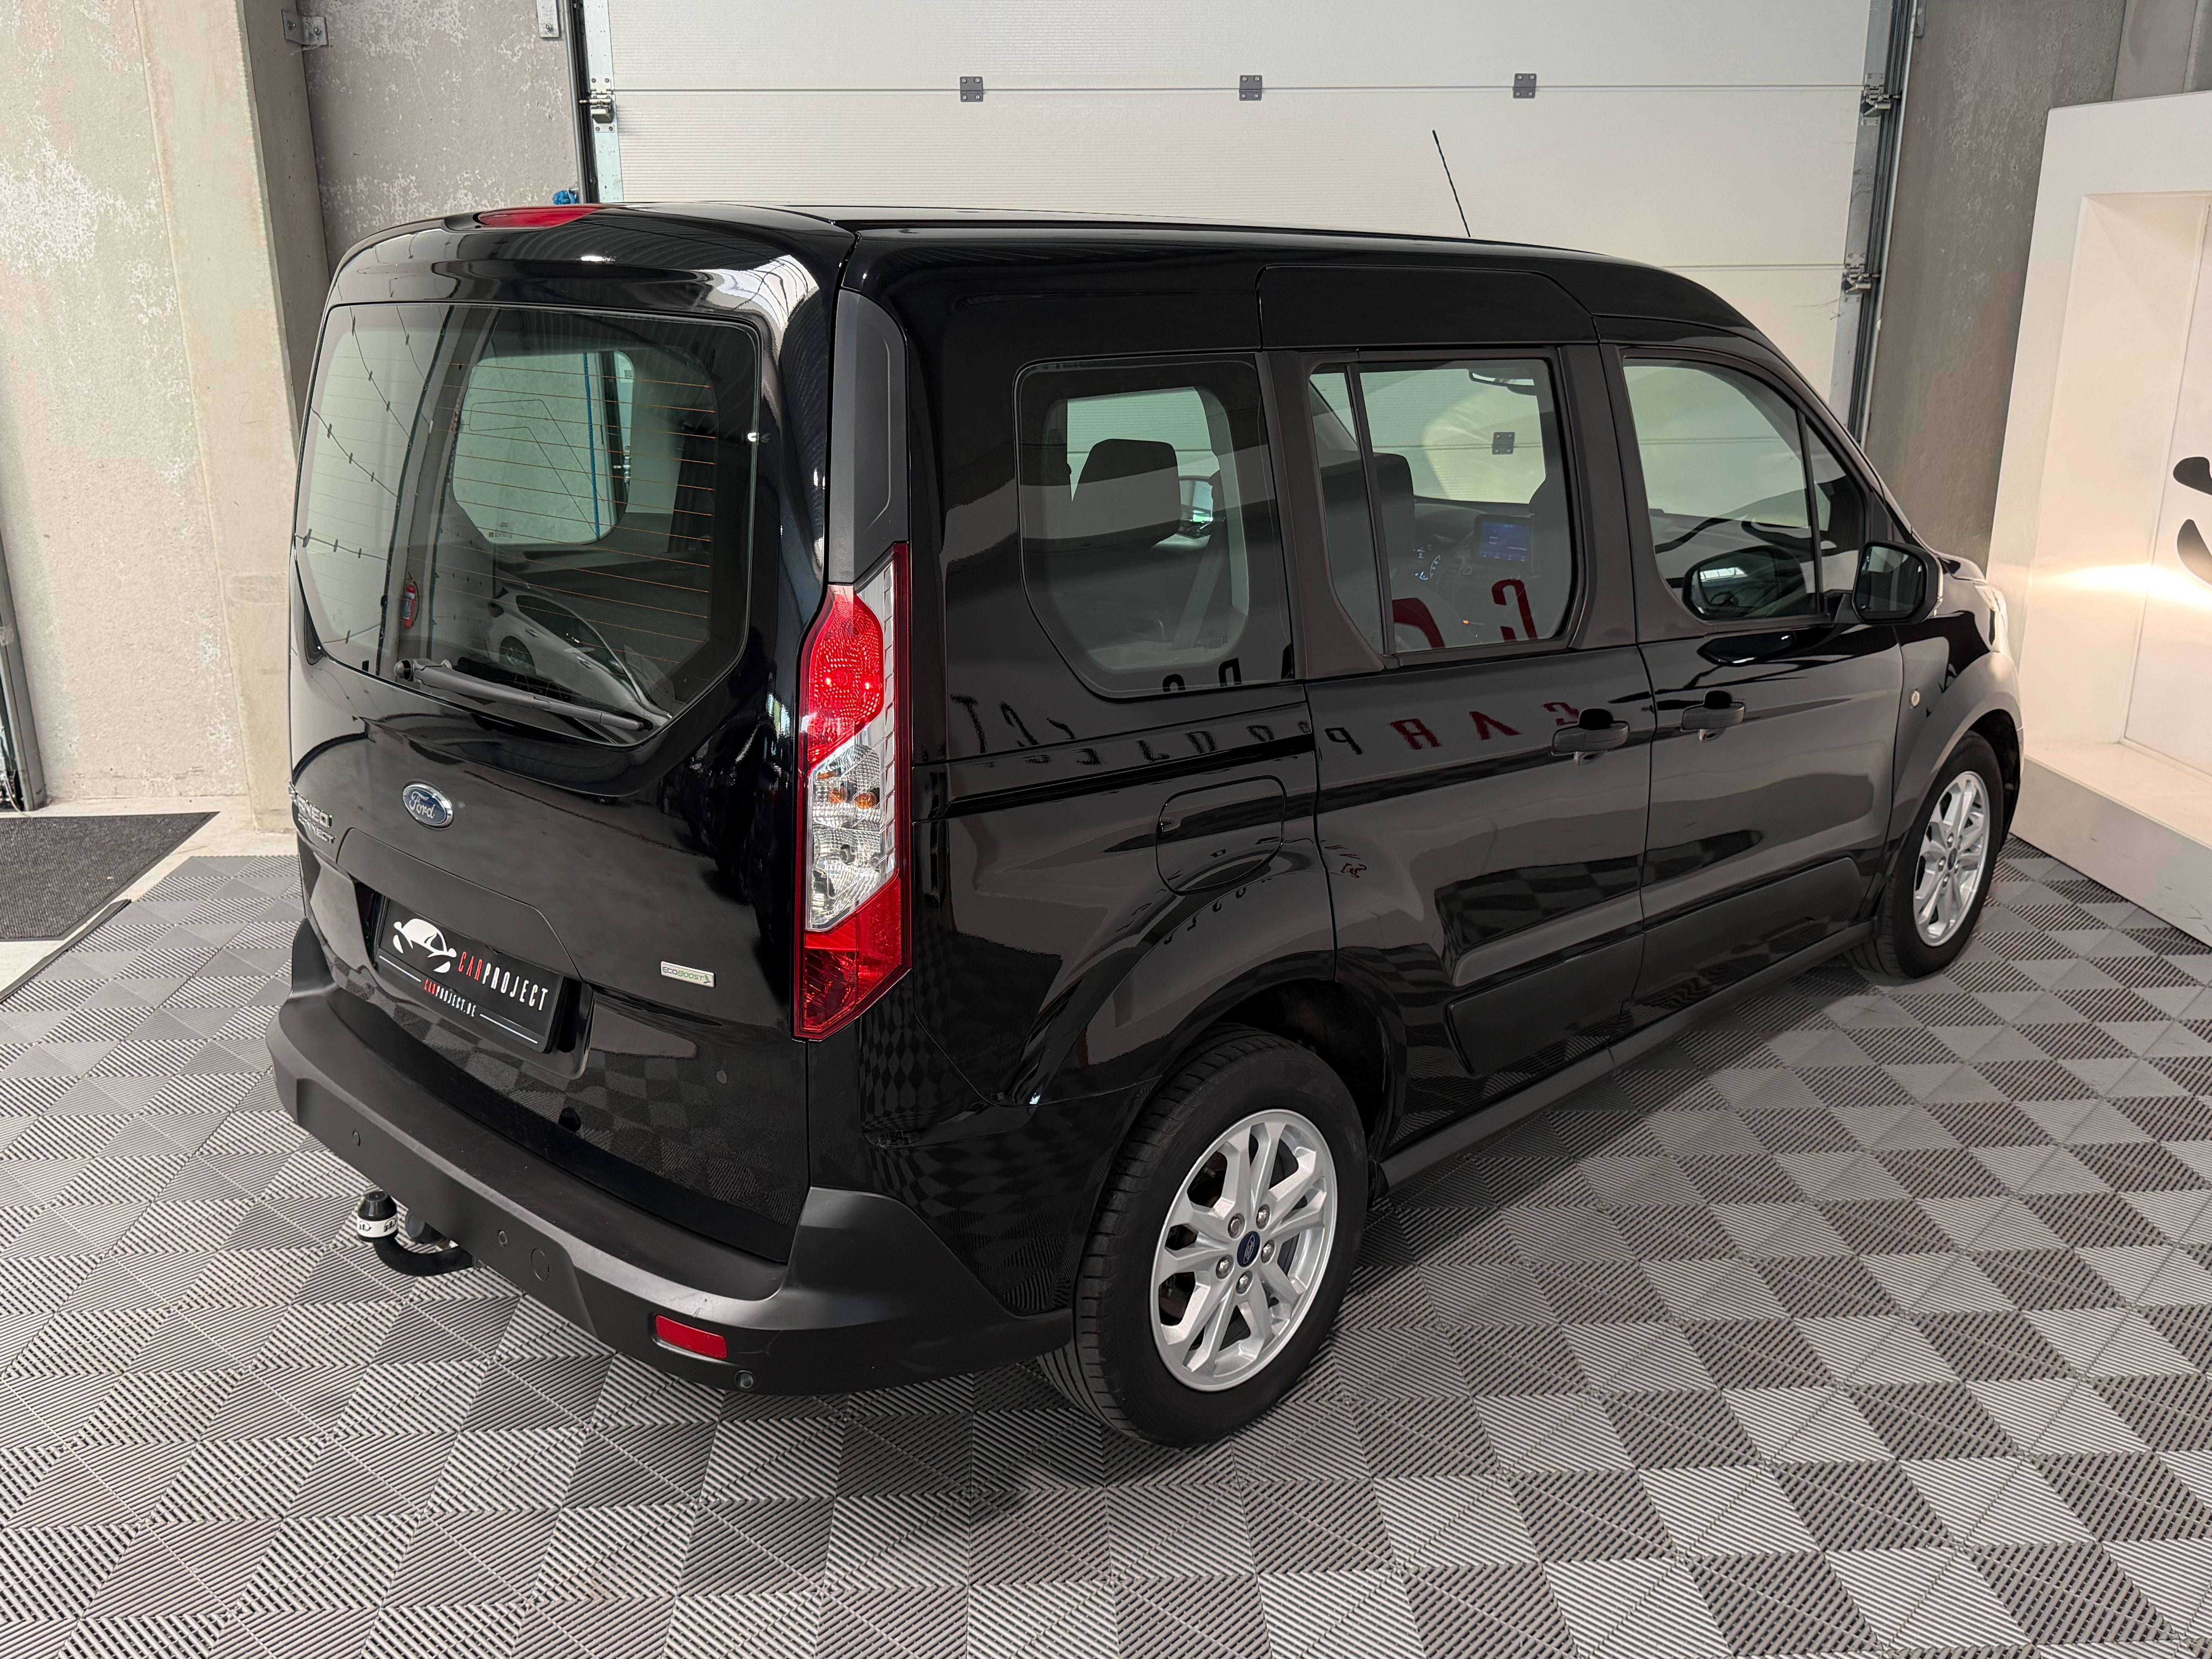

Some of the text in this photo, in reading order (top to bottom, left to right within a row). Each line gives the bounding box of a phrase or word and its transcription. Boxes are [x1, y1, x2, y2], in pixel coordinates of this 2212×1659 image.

[409, 791, 436, 819] Ford
[458, 951, 548, 1011] CARPROJECT
[662, 966, 704, 981] ECOBOOST
[424, 979, 477, 1017] CARPROJECT.DE
